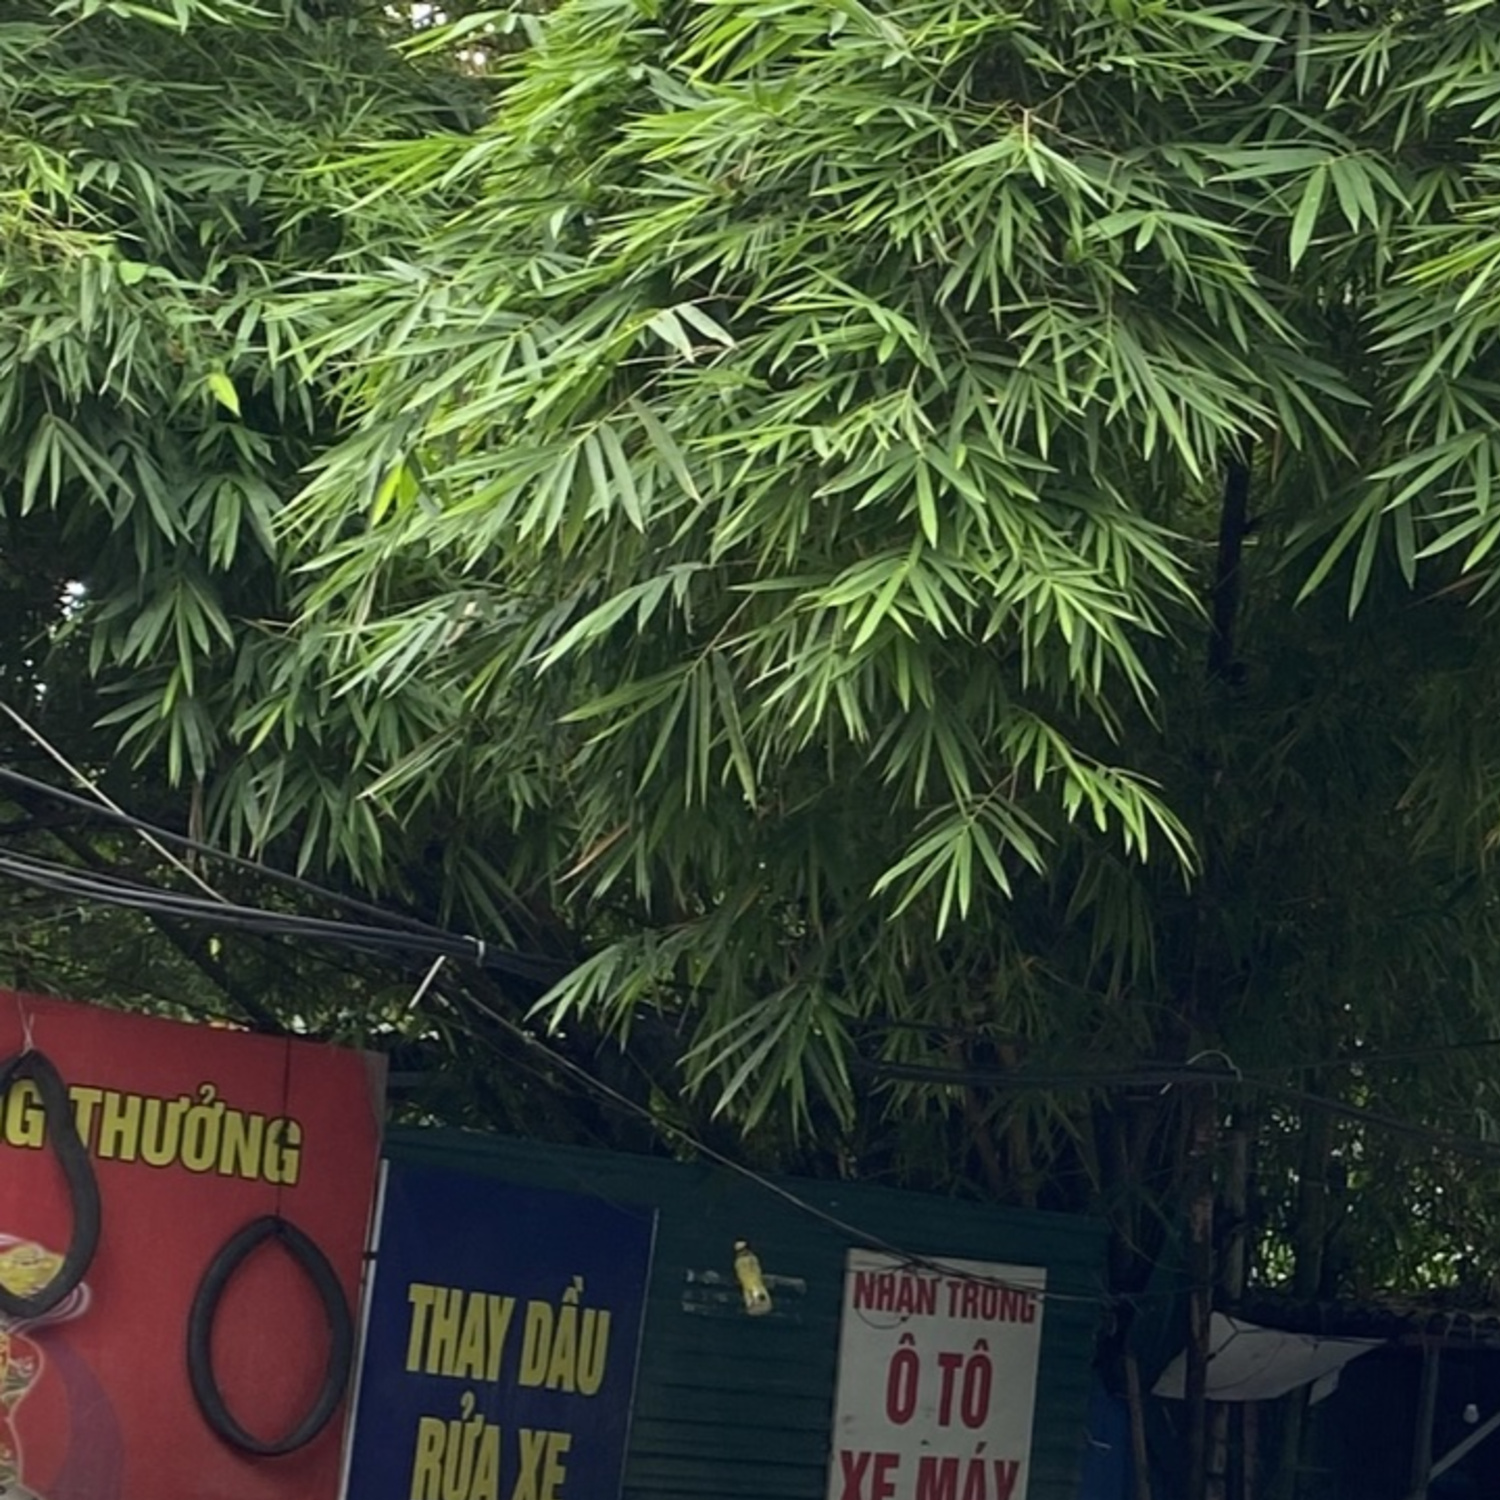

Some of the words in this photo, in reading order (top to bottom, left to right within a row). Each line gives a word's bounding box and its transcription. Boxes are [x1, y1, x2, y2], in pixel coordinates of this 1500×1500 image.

[69, 1083, 301, 1184] THƯỞNG
[405, 1283, 516, 1382] THAY
[518, 1276, 611, 1395] DẦU
[886, 1332, 920, 1426] Ô
[938, 1338, 993, 1429] TÔ
